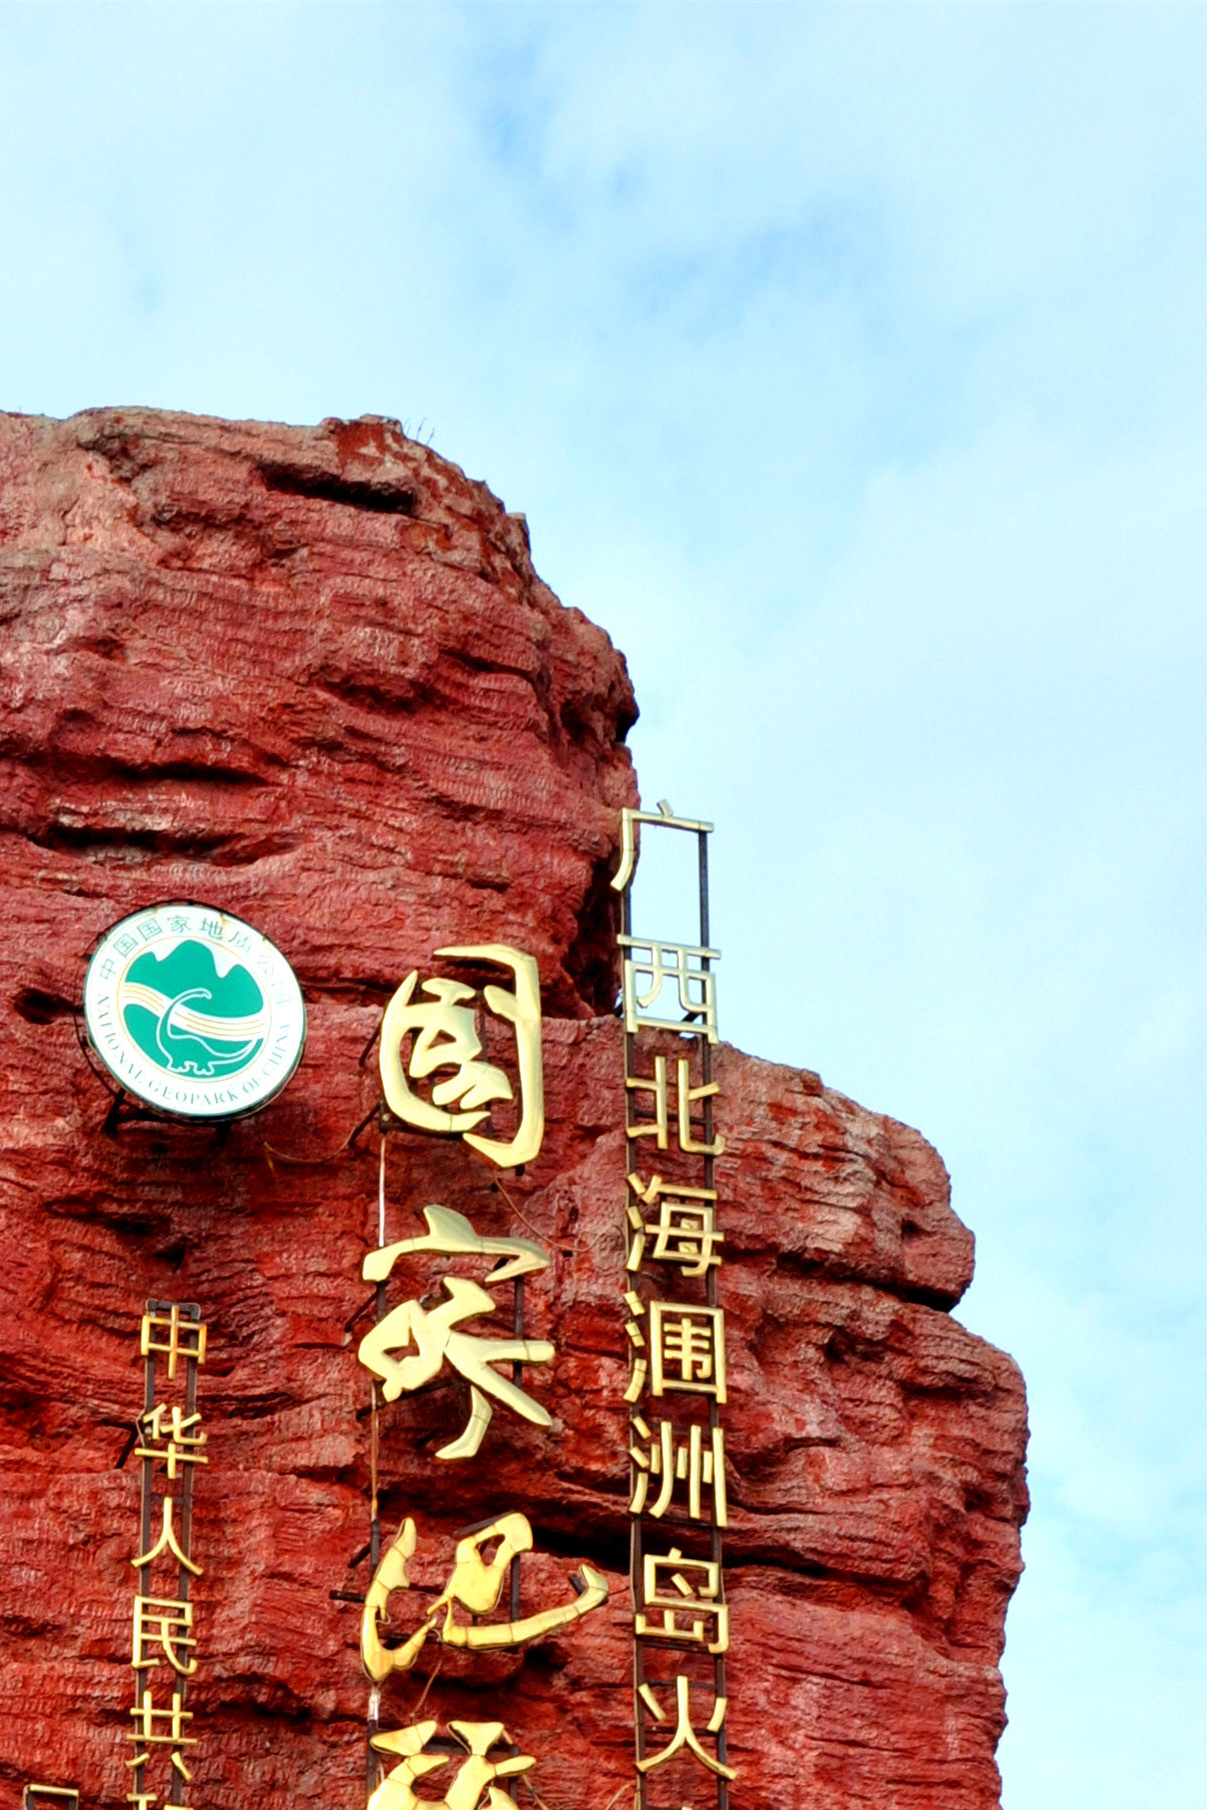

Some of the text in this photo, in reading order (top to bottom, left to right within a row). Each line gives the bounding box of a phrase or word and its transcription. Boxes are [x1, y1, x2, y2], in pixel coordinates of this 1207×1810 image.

[98, 914, 293, 1006] 中国国家地质公园
[97, 992, 291, 1106] NATIONAL GEOPARK OF CHINA
